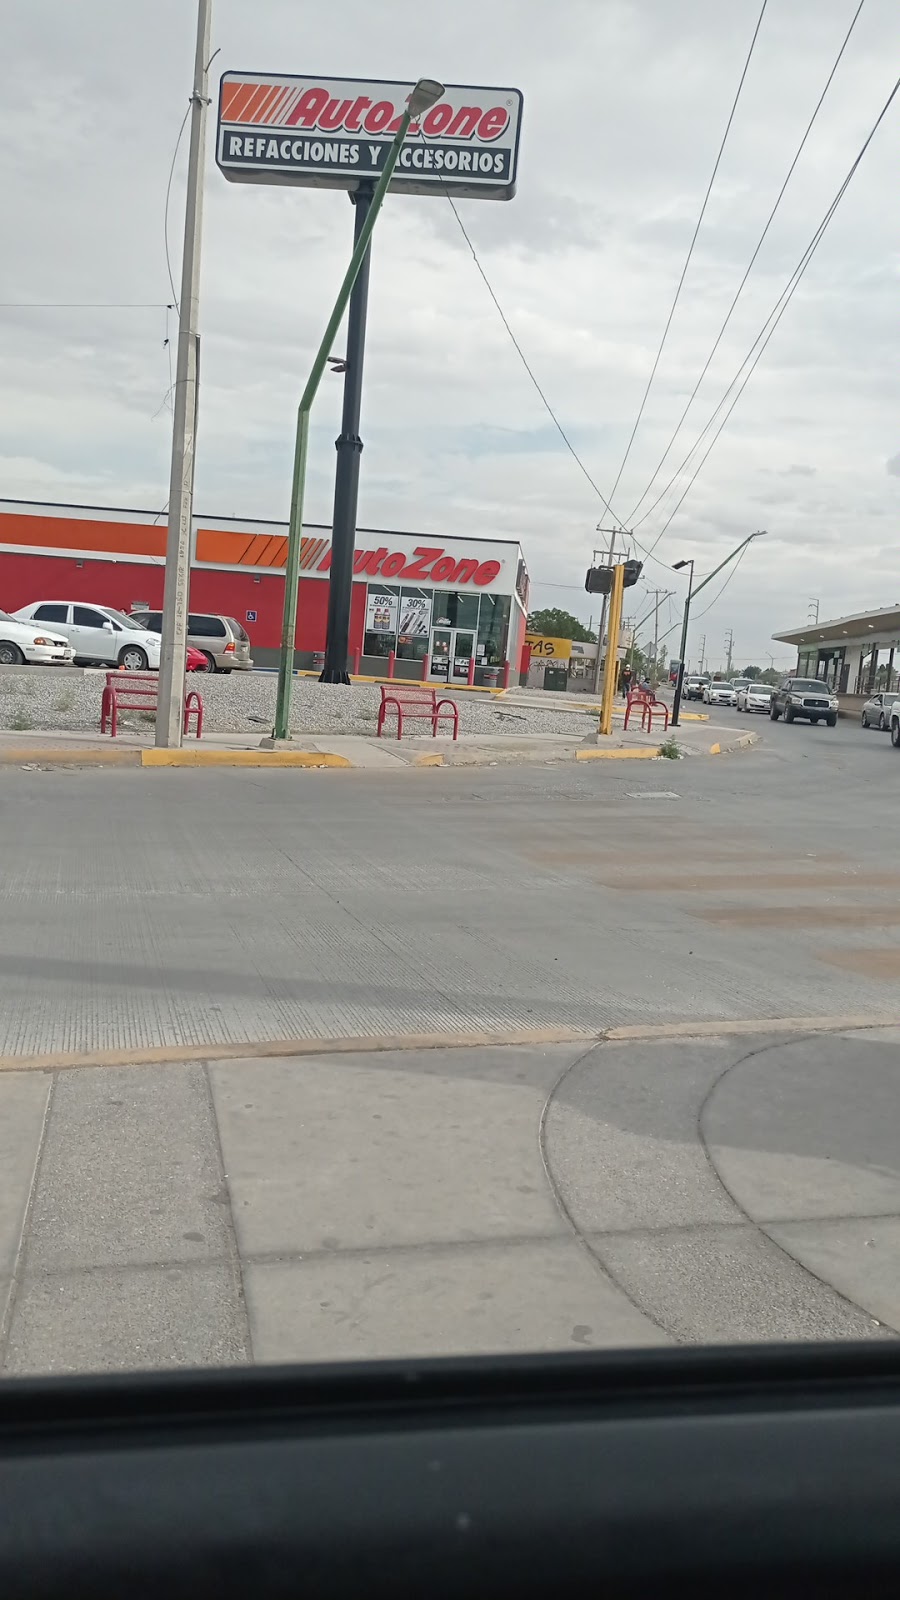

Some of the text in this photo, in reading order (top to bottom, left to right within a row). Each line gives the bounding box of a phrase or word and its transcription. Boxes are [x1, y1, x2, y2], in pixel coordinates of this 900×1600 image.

[229, 136, 504, 173] REFACCIONES Y CCESORIOS
[373, 596, 393, 606] 50%
[406, 598, 426, 609] 30%
